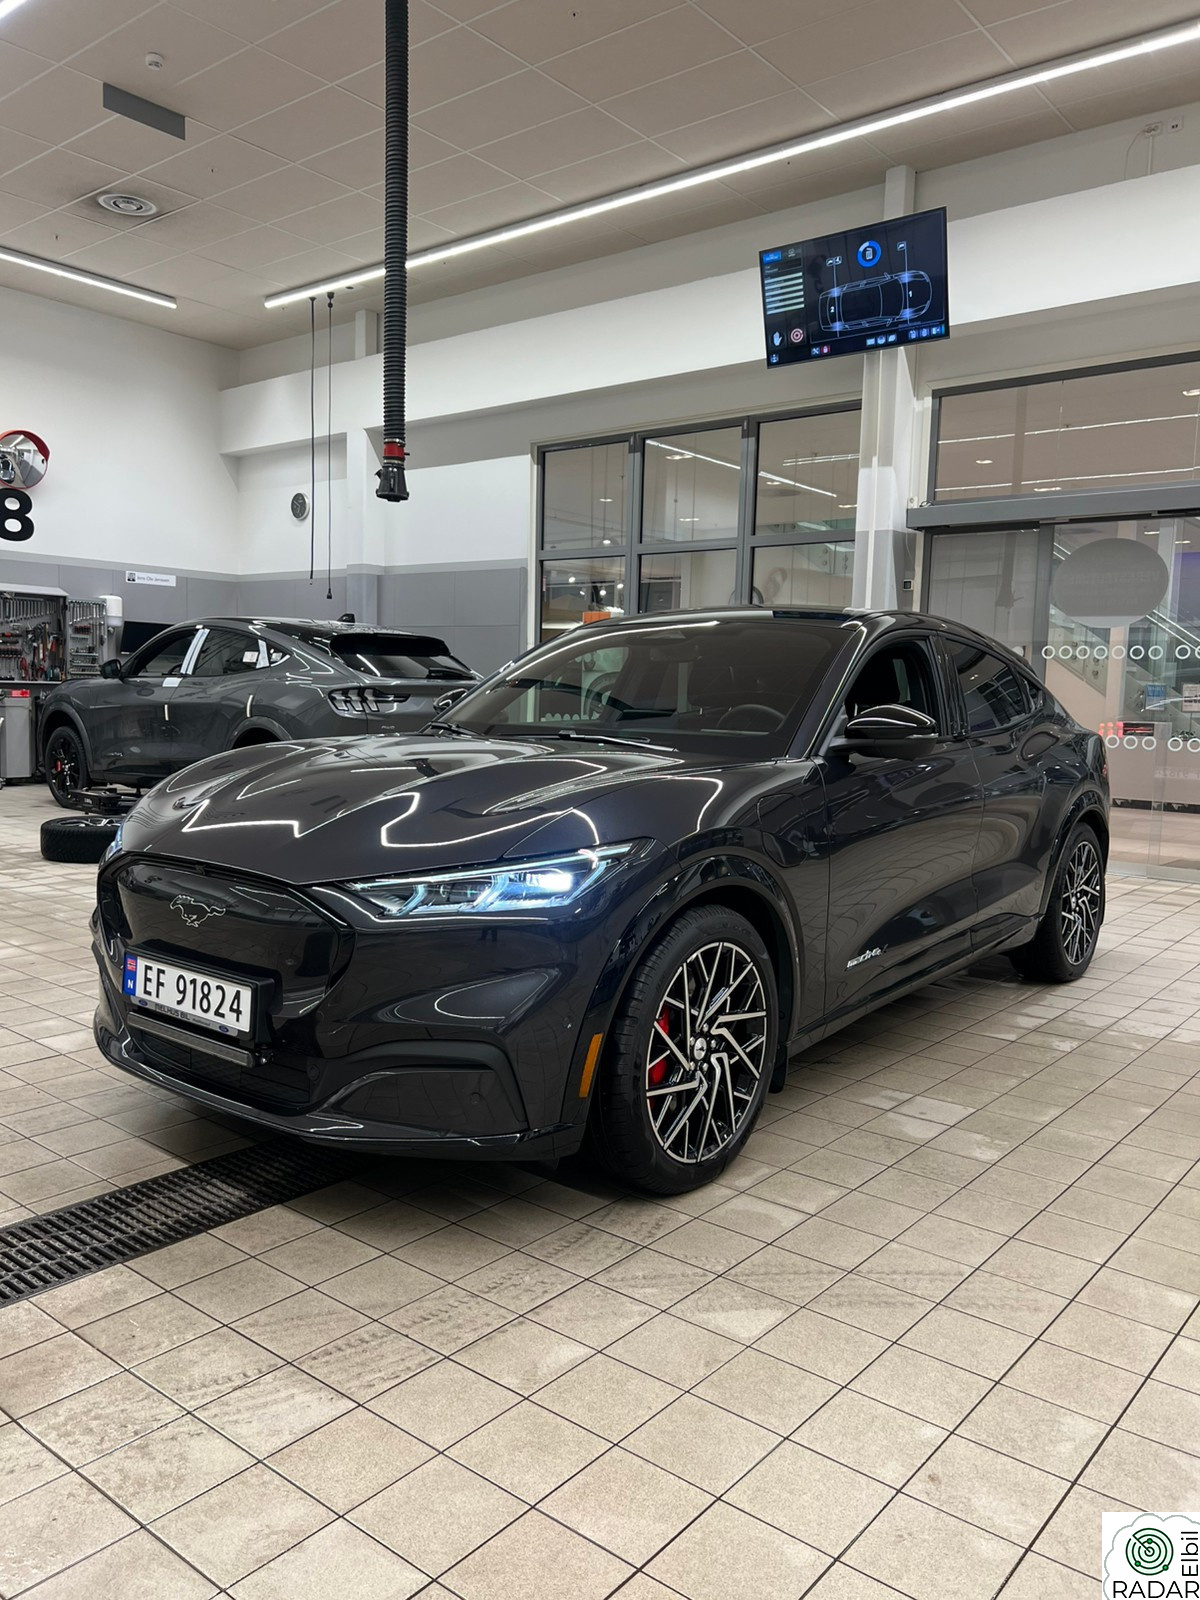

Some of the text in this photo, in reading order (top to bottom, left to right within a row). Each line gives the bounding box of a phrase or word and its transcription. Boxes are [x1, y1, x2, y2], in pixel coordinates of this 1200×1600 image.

[0, 488, 35, 541] 8
[127, 979, 134, 990] N
[143, 964, 243, 1023] EF 91824
